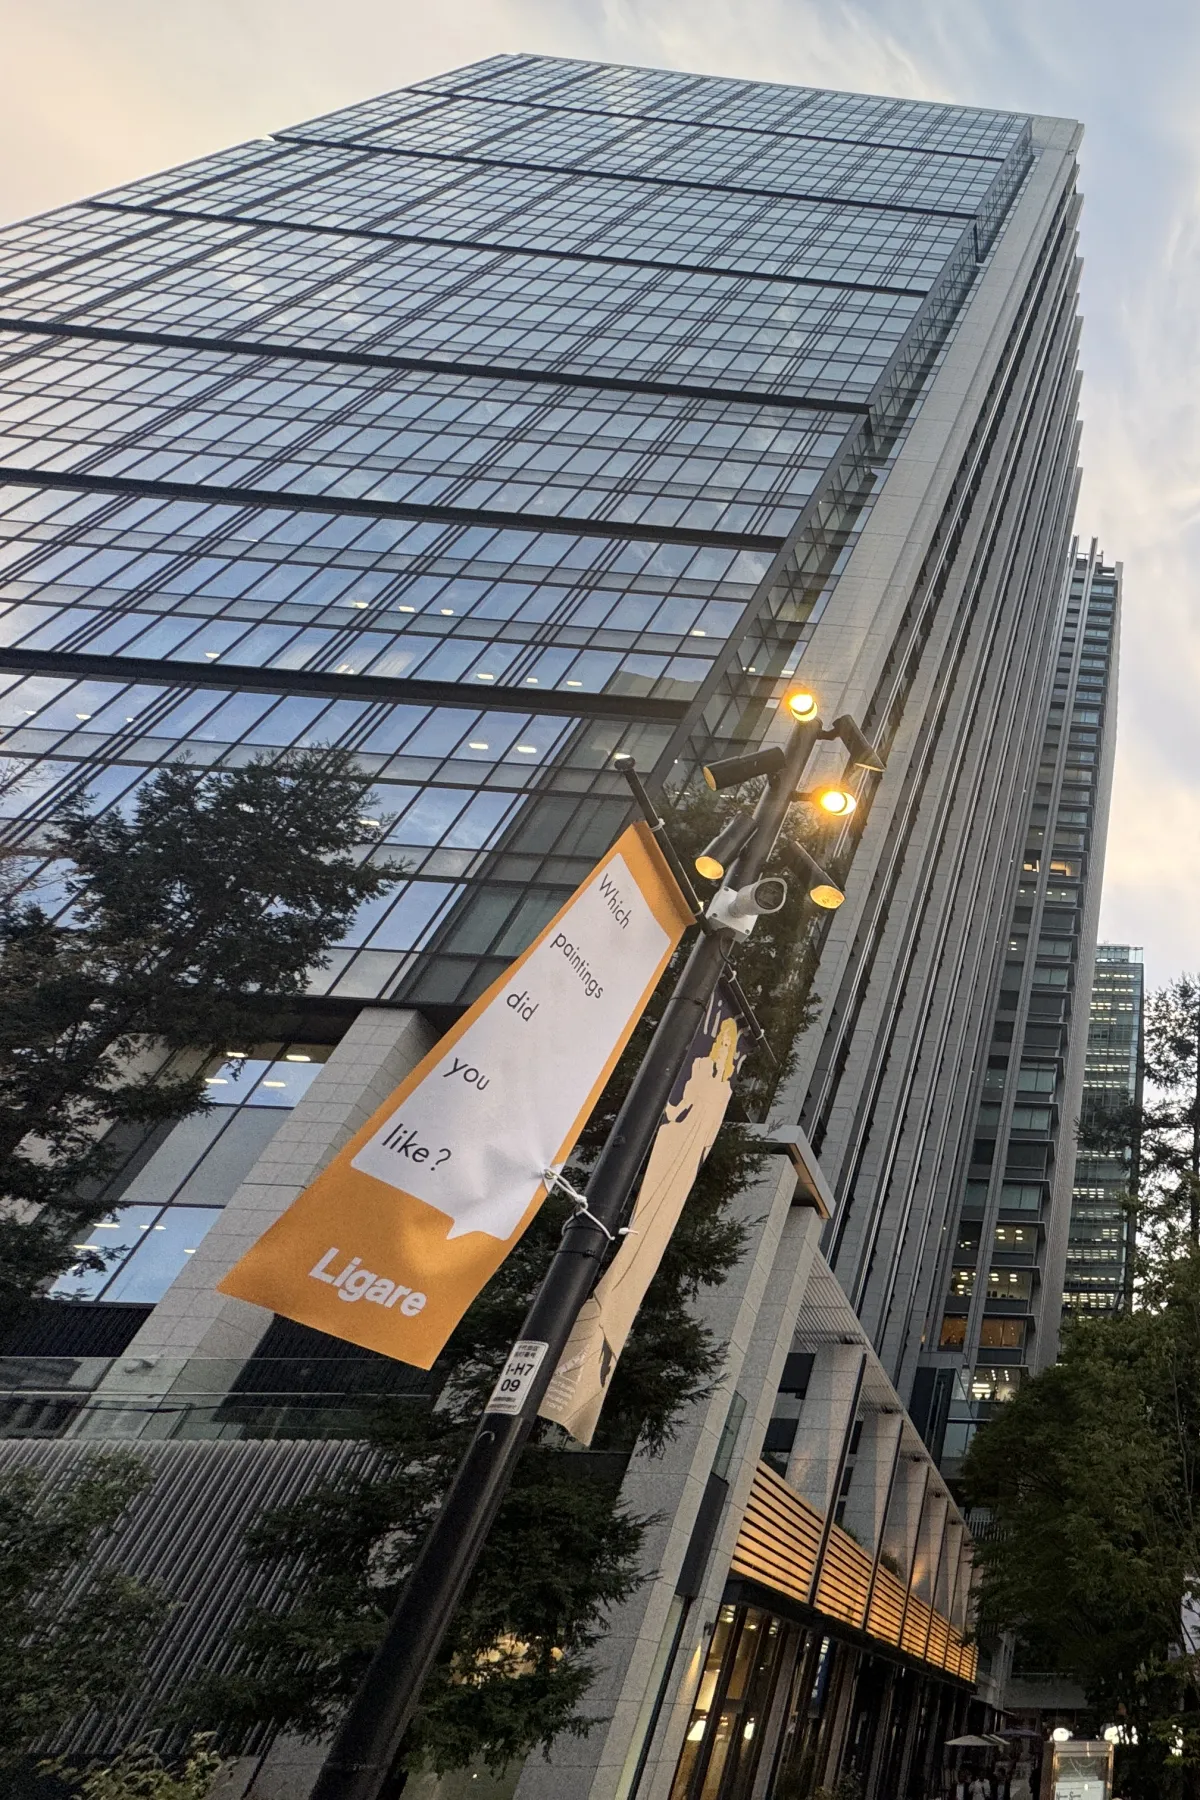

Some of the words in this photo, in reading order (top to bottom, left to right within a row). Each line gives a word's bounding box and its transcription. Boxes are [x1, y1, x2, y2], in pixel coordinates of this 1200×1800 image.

[599, 873, 632, 929] Which
[550, 932, 604, 999] paintings
[506, 991, 539, 1022] did
[442, 1057, 491, 1091] you
[382, 1123, 452, 1171] like?
[308, 1247, 427, 1317] Ligare
[501, 1379, 521, 1392] 09
[505, 1363, 535, 1376] 1-H7
